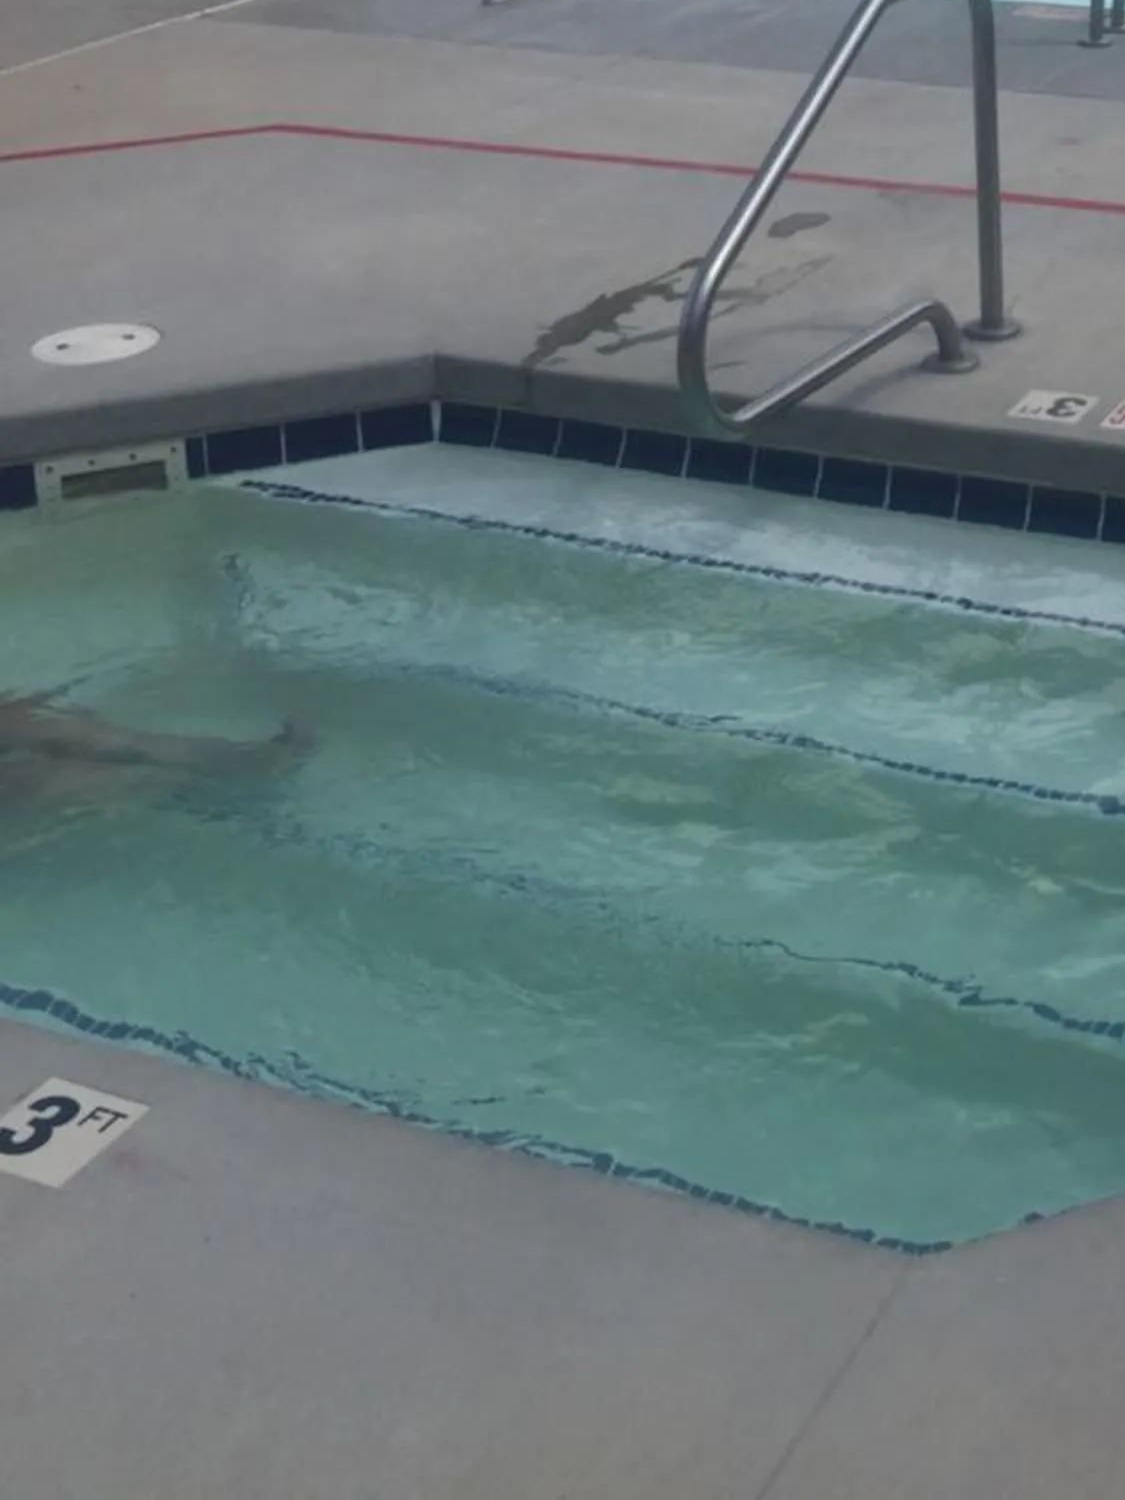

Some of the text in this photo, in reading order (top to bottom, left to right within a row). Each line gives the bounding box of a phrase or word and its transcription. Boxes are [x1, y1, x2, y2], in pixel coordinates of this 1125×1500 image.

[1046, 396, 1088, 418] 3
[0, 1095, 129, 1156] 3 FT
